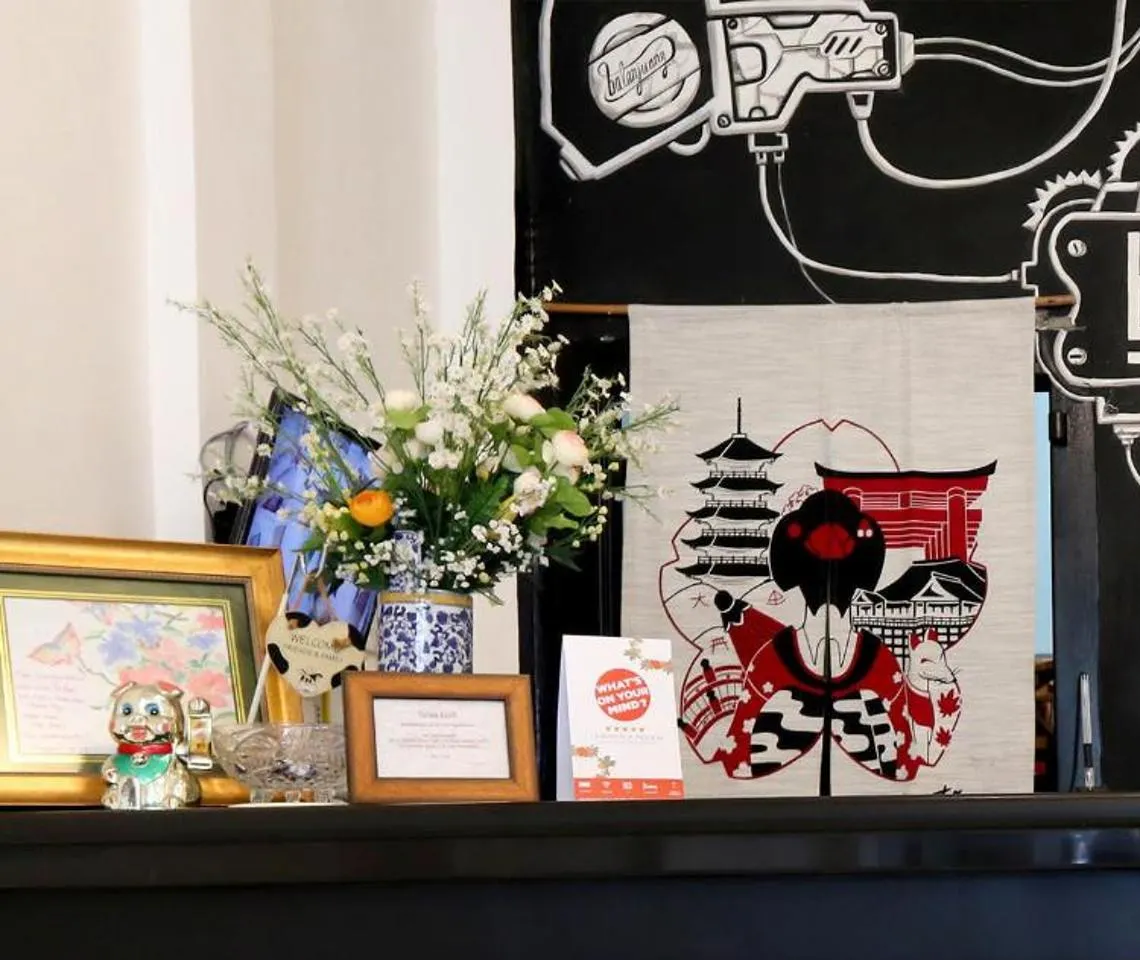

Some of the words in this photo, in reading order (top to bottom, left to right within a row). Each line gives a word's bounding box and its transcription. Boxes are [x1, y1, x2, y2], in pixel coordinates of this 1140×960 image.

[291, 634, 334, 650] WELCOM
[598, 676, 642, 694] WHAT'S
[598, 696, 615, 705] ON
[617, 689, 649, 702] YOUR
